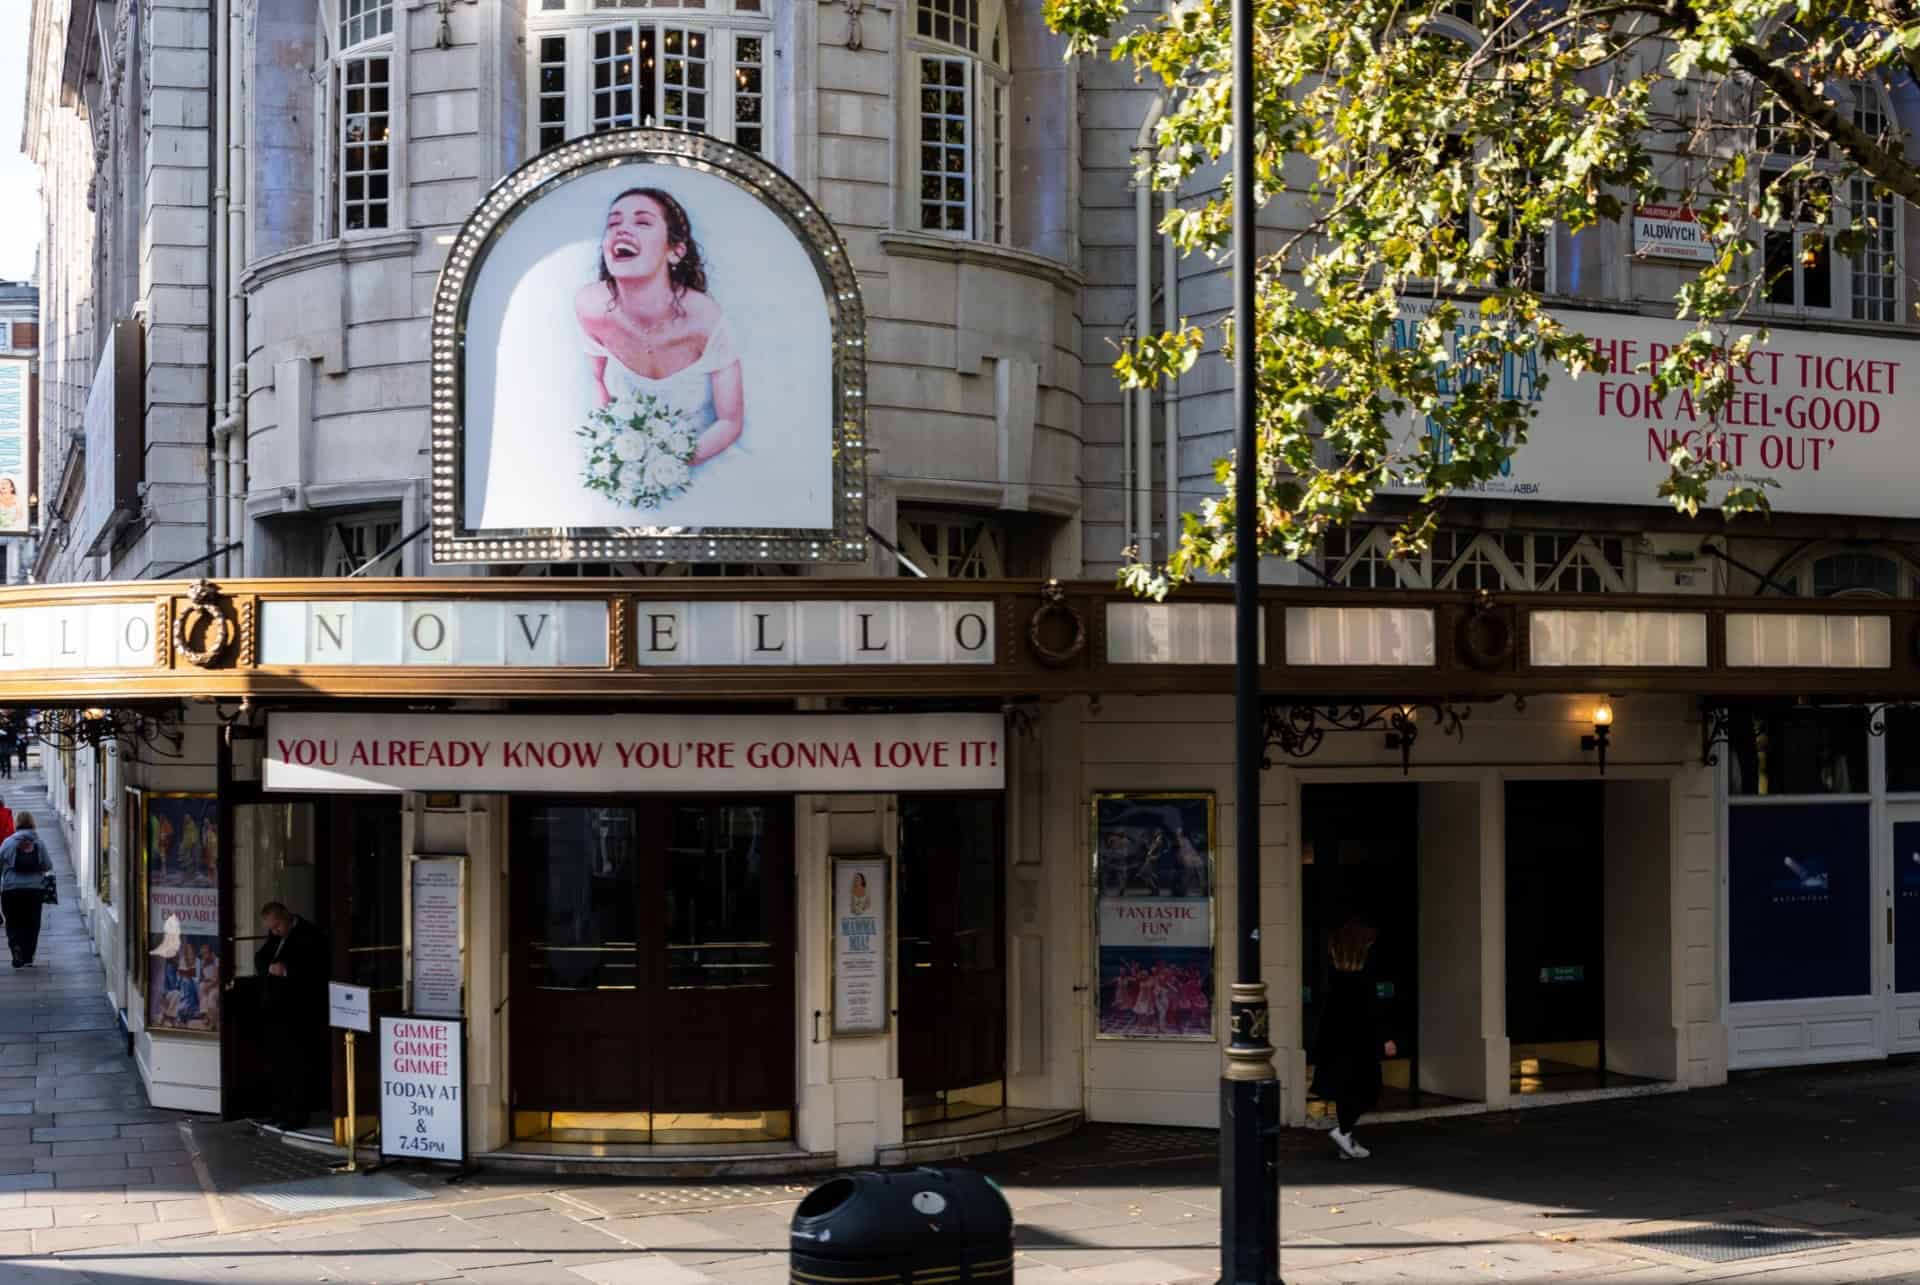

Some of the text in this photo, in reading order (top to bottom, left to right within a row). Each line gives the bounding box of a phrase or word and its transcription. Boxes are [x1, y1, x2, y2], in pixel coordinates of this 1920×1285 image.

[1643, 223, 1696, 241] ALDWYCH
[1585, 337, 1638, 375] HE
[1795, 353, 1902, 395] TICKET
[1599, 381, 1881, 433] FOR A EEL-GOOD
[277, 739, 998, 769] YOU ALREADY KNOW YOU'RE GONNA LOVE IT!
[393, 1022, 448, 1040] GIMME!
[393, 1041, 448, 1059] GIMME!
[393, 1059, 448, 1077] GIMME!
[384, 1081, 460, 1101] TODAY AT
[408, 1101, 434, 1117] 3PM
[415, 1118, 427, 1134] &
[400, 1135, 446, 1153] 7.45PM
